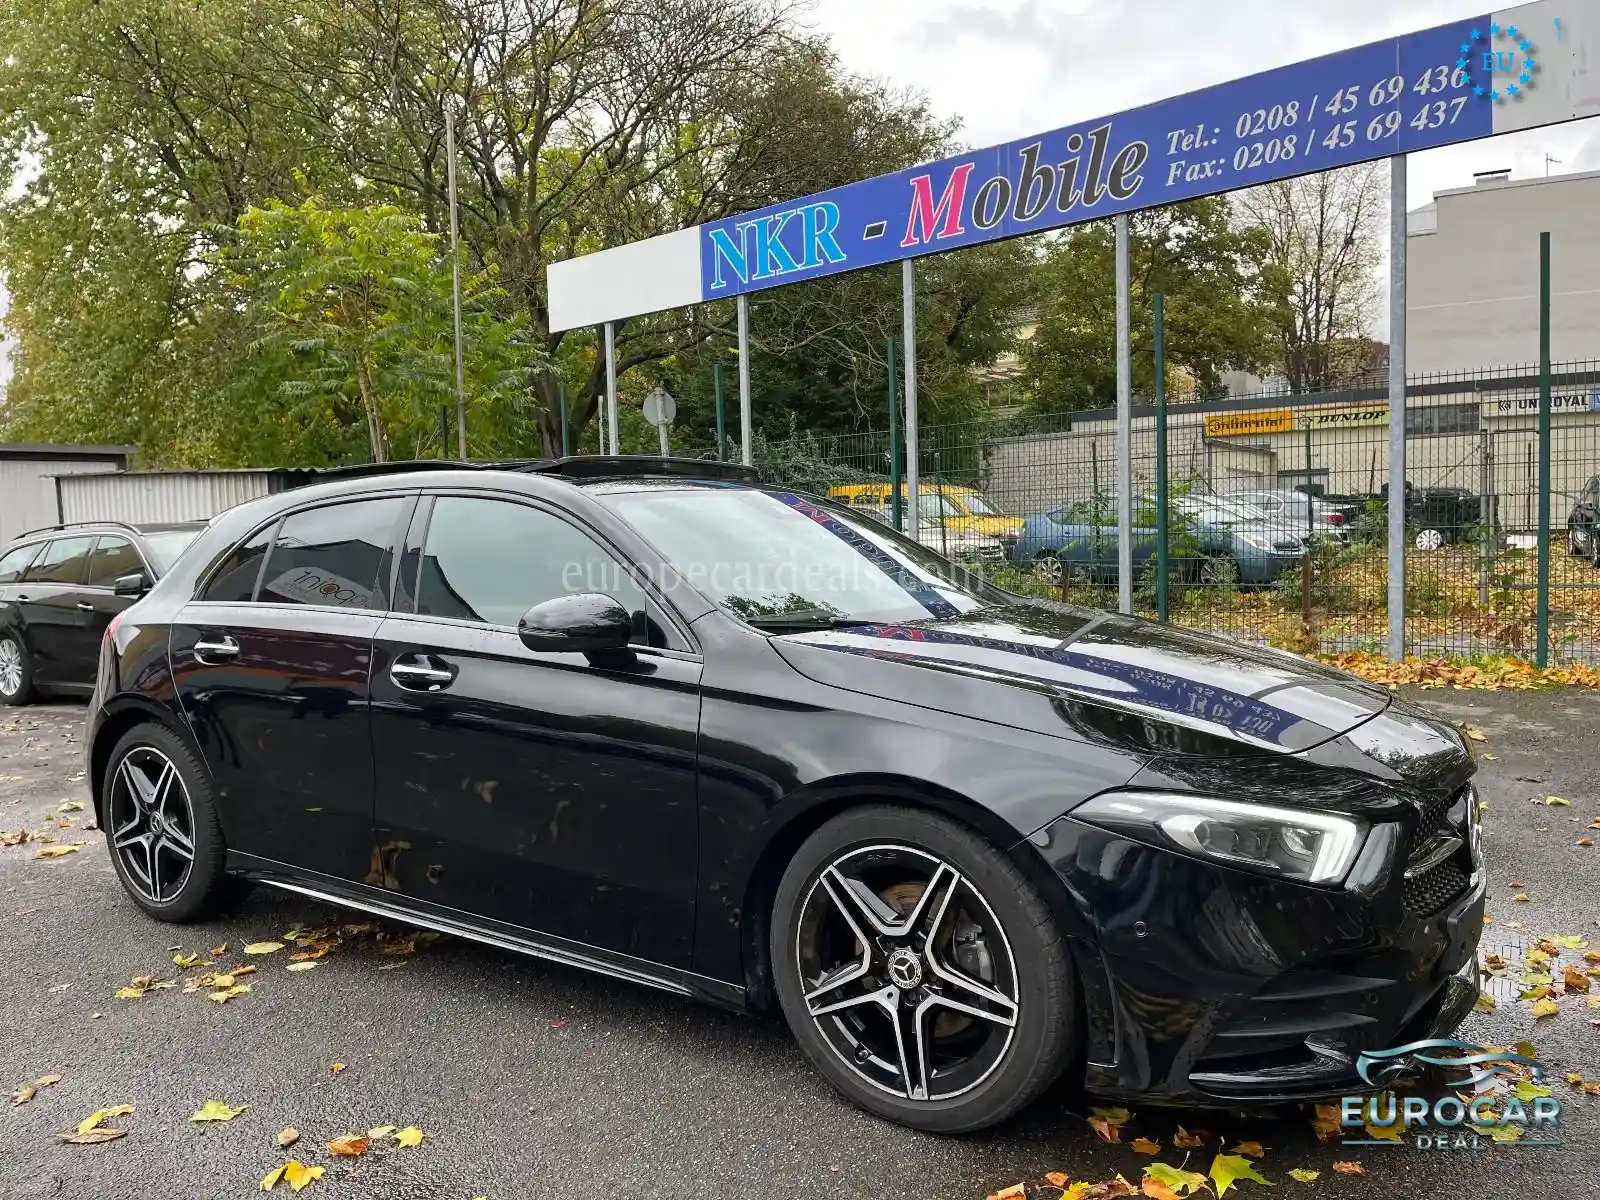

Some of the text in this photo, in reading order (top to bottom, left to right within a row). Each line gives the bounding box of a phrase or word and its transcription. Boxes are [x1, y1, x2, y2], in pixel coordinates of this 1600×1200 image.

[1165, 96, 1468, 187] Fax: 0208 / 45 69 437
[1166, 59, 1470, 155] Tel.: 0208 / 45 69 436
[709, 122, 1149, 289] NKR - Mobile
[1317, 410, 1386, 424] DUNLOP
